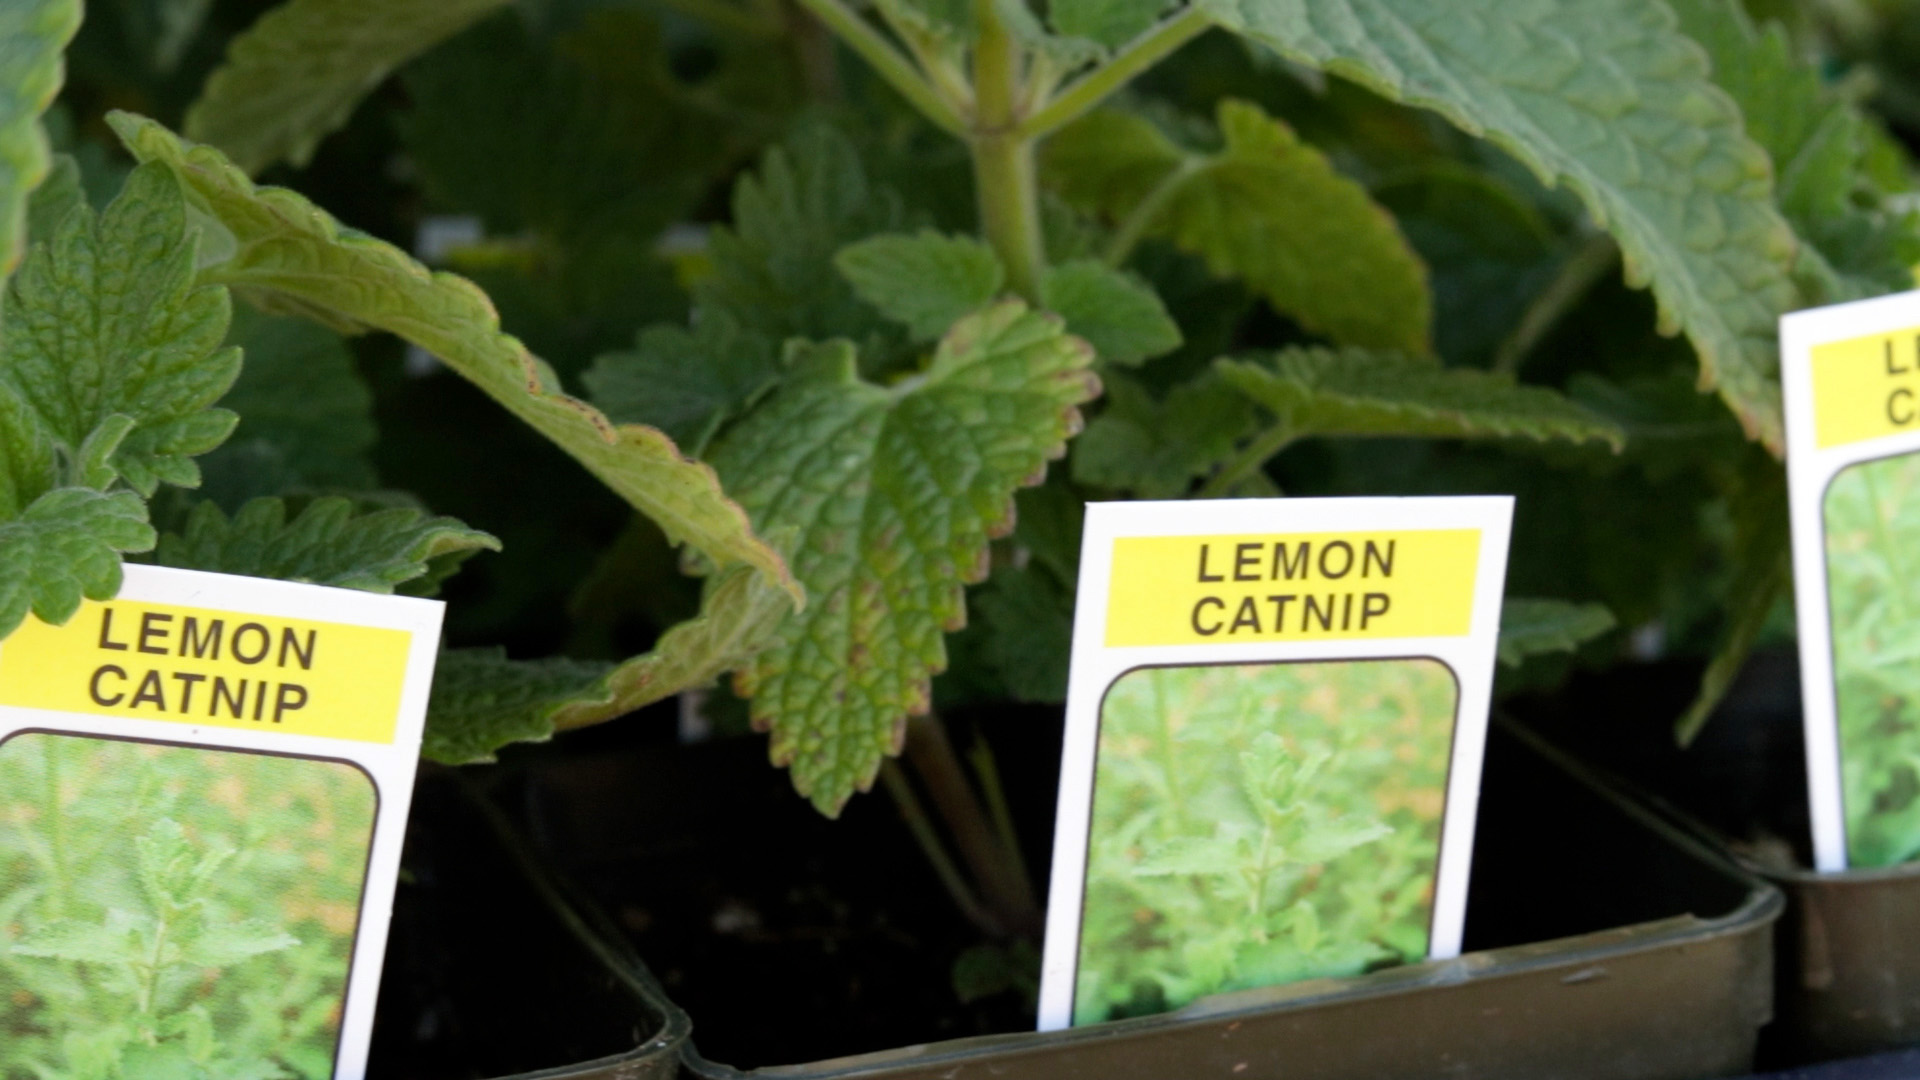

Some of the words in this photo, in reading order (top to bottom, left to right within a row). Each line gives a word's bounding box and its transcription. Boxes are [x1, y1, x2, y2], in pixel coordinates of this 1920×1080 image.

[1198, 540, 1396, 582] LEMON
[98, 608, 317, 671] LEMON
[1192, 592, 1391, 636] CATNIP
[90, 663, 309, 723] CATNIP
